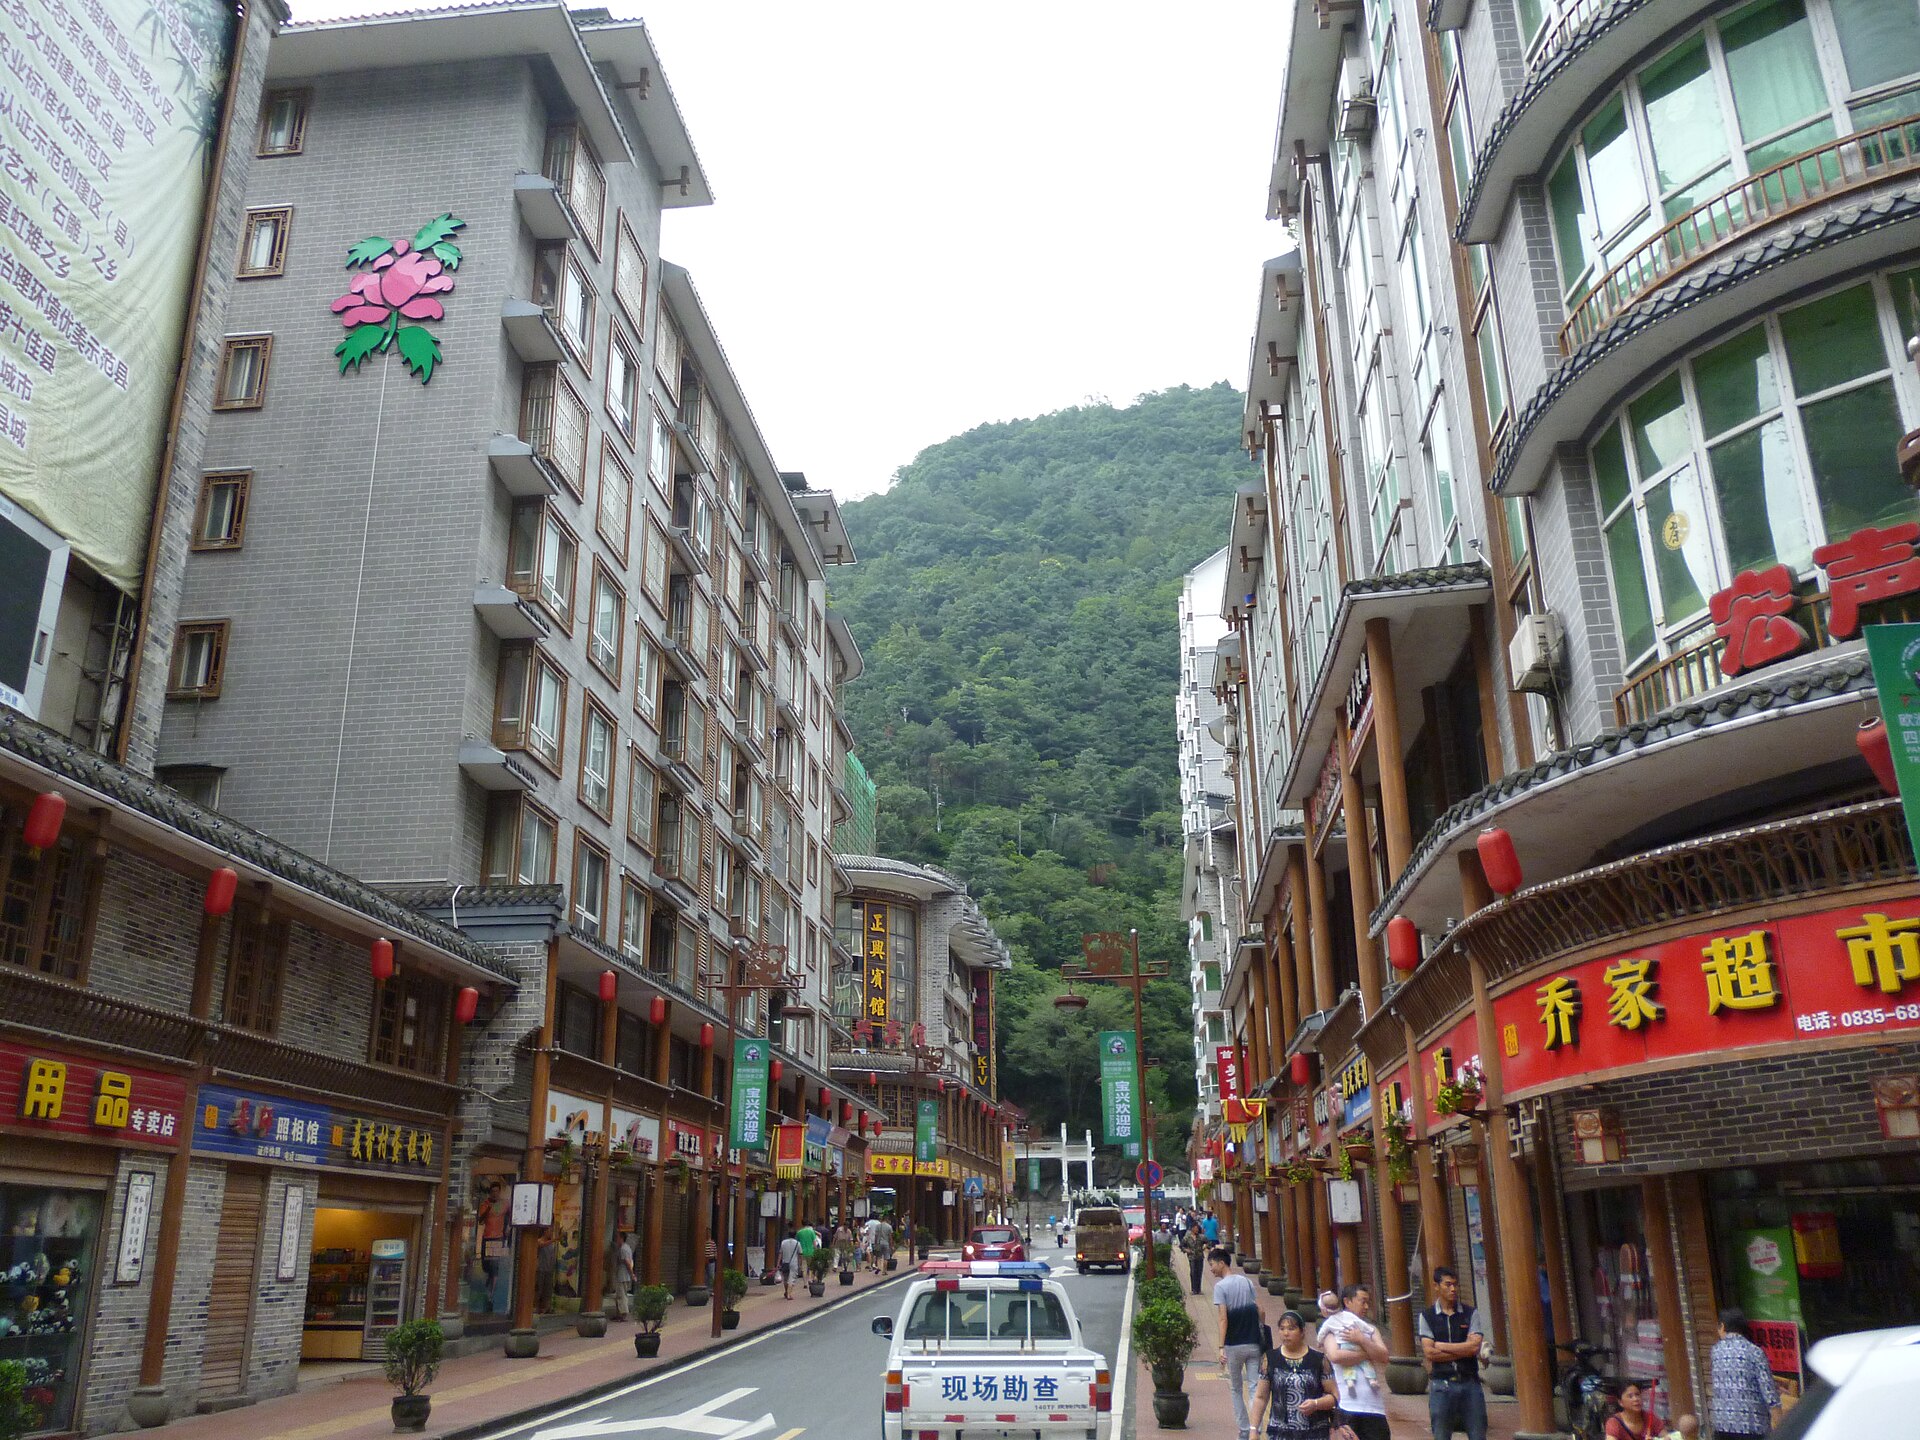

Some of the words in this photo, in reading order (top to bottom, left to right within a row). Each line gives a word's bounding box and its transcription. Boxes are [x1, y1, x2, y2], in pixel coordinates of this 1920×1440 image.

[1536, 913, 1920, 1051] 乔家超市
[1841, 1003, 1920, 1027] 0835-68
[24, 1059, 132, 1128] 用品
[977, 1056, 988, 1085] KTV
[744, 1088, 760, 1142] 宝兴欢迎您
[1115, 1081, 1131, 1137] 宝兴欢迎您
[941, 1375, 1059, 1402] 现场勘查
